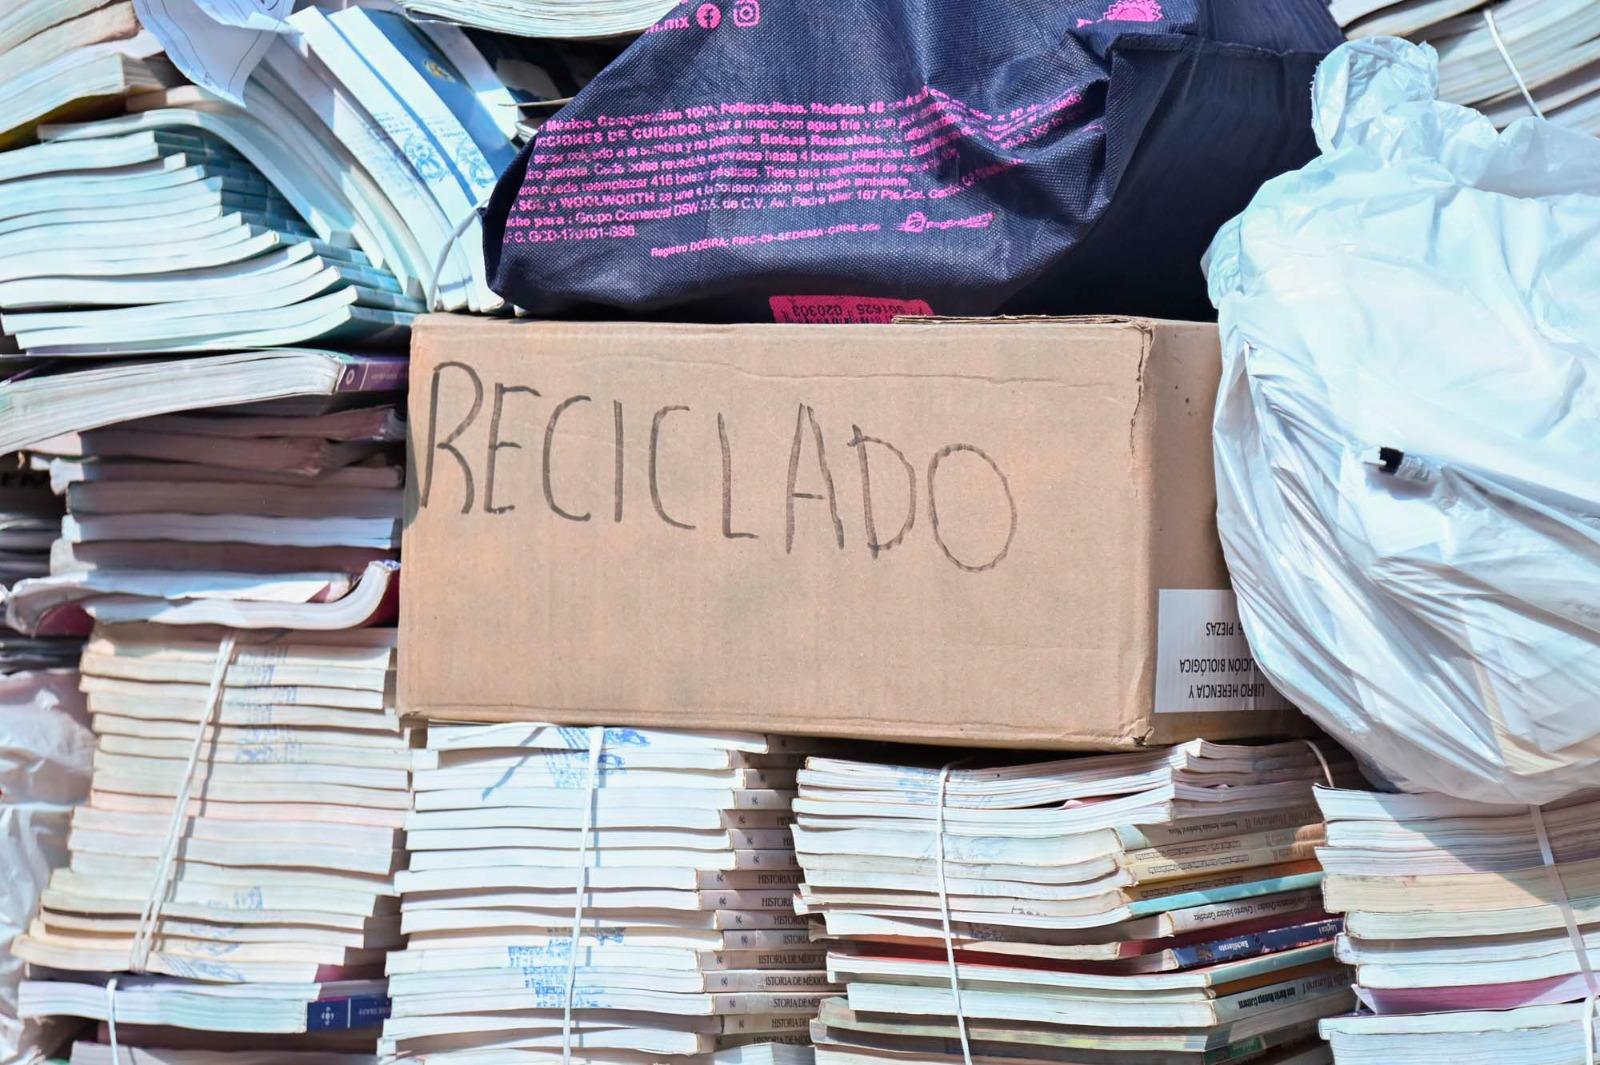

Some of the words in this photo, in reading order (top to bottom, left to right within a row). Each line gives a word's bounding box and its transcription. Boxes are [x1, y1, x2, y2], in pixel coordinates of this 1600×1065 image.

[811, 102, 865, 115] Medidas
[807, 121, 838, 133] agua
[695, 140, 708, 151] no
[764, 150, 798, 162] hasta
[765, 165, 797, 178] Tiene
[881, 162, 898, 174] de
[560, 191, 656, 210] WOOLWORTH
[795, 181, 814, 192] del
[816, 177, 851, 191] medio
[853, 176, 909, 187] ambiente
[534, 214, 565, 229] para
[576, 211, 613, 226] Grupo
[615, 205, 673, 222] Comercial
[673, 202, 699, 217] DSW
[722, 198, 738, 209] de
[791, 195, 826, 208] Padre
[650, 242, 688, 259] Registro
[420, 361, 1017, 571] RECICLADO
[1206, 622, 1234, 636] PIEZAS
[1179, 658, 1227, 676] BIOLÓGICA
[1188, 684, 1194, 699] Y
[1196, 683, 1239, 698] HERENCIA
[792, 976, 802, 986] DE
